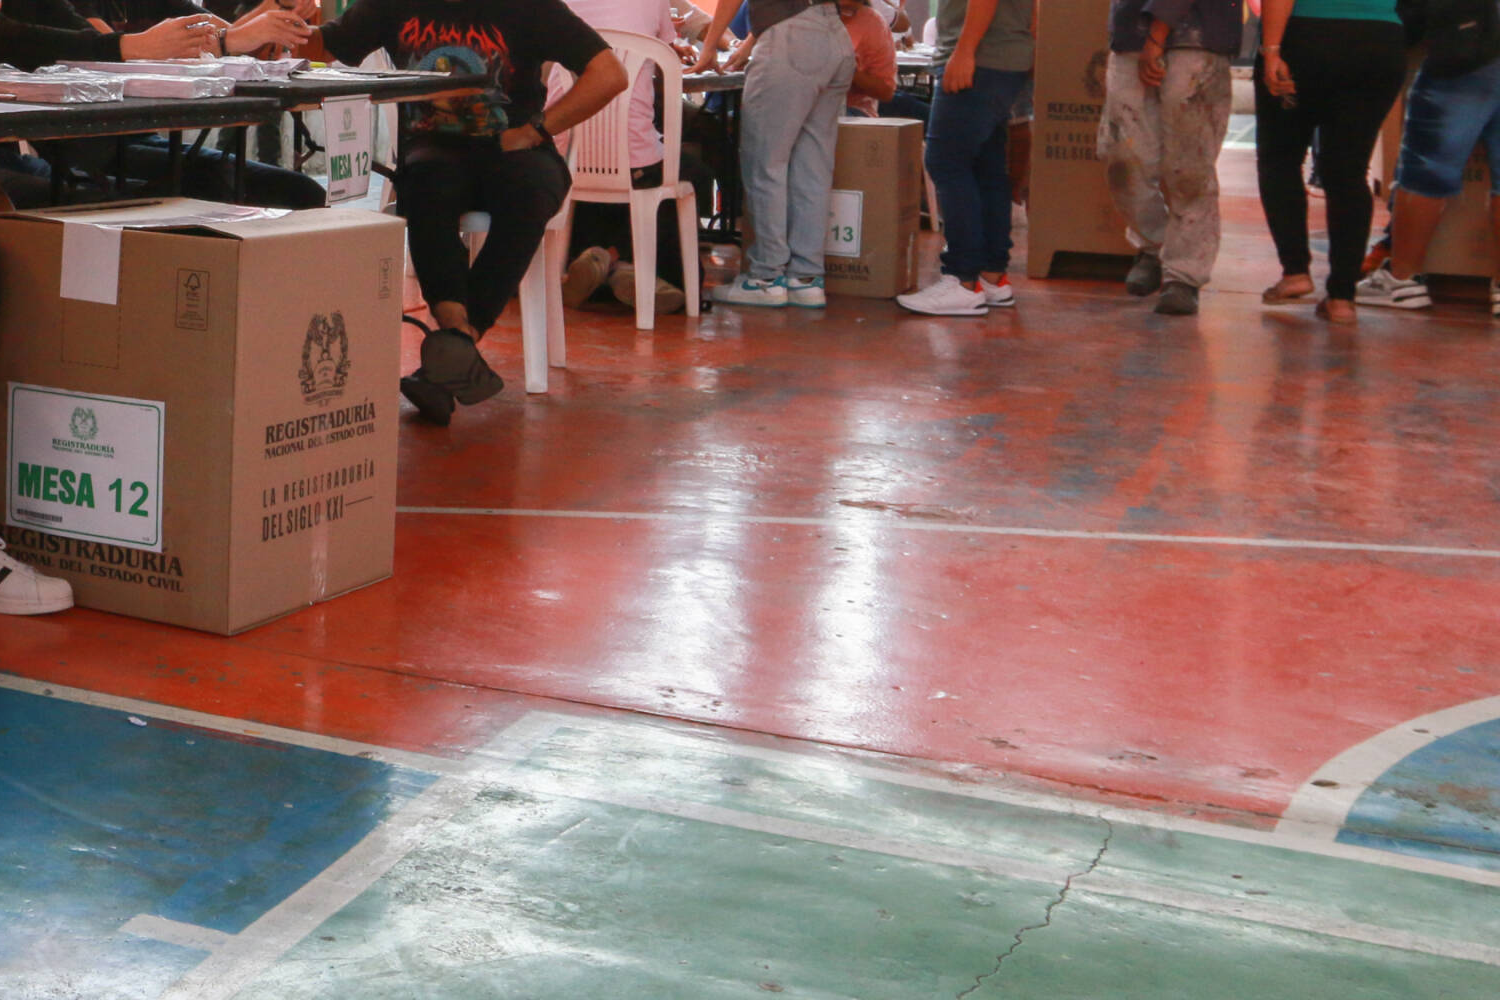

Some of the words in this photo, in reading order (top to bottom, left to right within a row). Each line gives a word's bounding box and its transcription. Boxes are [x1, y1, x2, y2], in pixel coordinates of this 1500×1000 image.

[330, 153, 352, 182] MESA
[356, 151, 369, 176] 12
[831, 224, 854, 242] 13
[265, 397, 376, 445] REGISTRADURÍA
[265, 440, 304, 459] NACIONAL
[356, 423, 375, 436] CIVIL
[18, 462, 95, 508] MESA
[108, 478, 149, 517] 12
[263, 488, 276, 508] LA
[284, 458, 374, 502] REGISTRADURÍA
[262, 512, 284, 542] DEL
[286, 501, 321, 534] SIGLO
[326, 494, 344, 521] XXI
[59, 558, 84, 572] DEL
[90, 565, 143, 585] ESTADO
[147, 575, 184, 593] CIVIL
